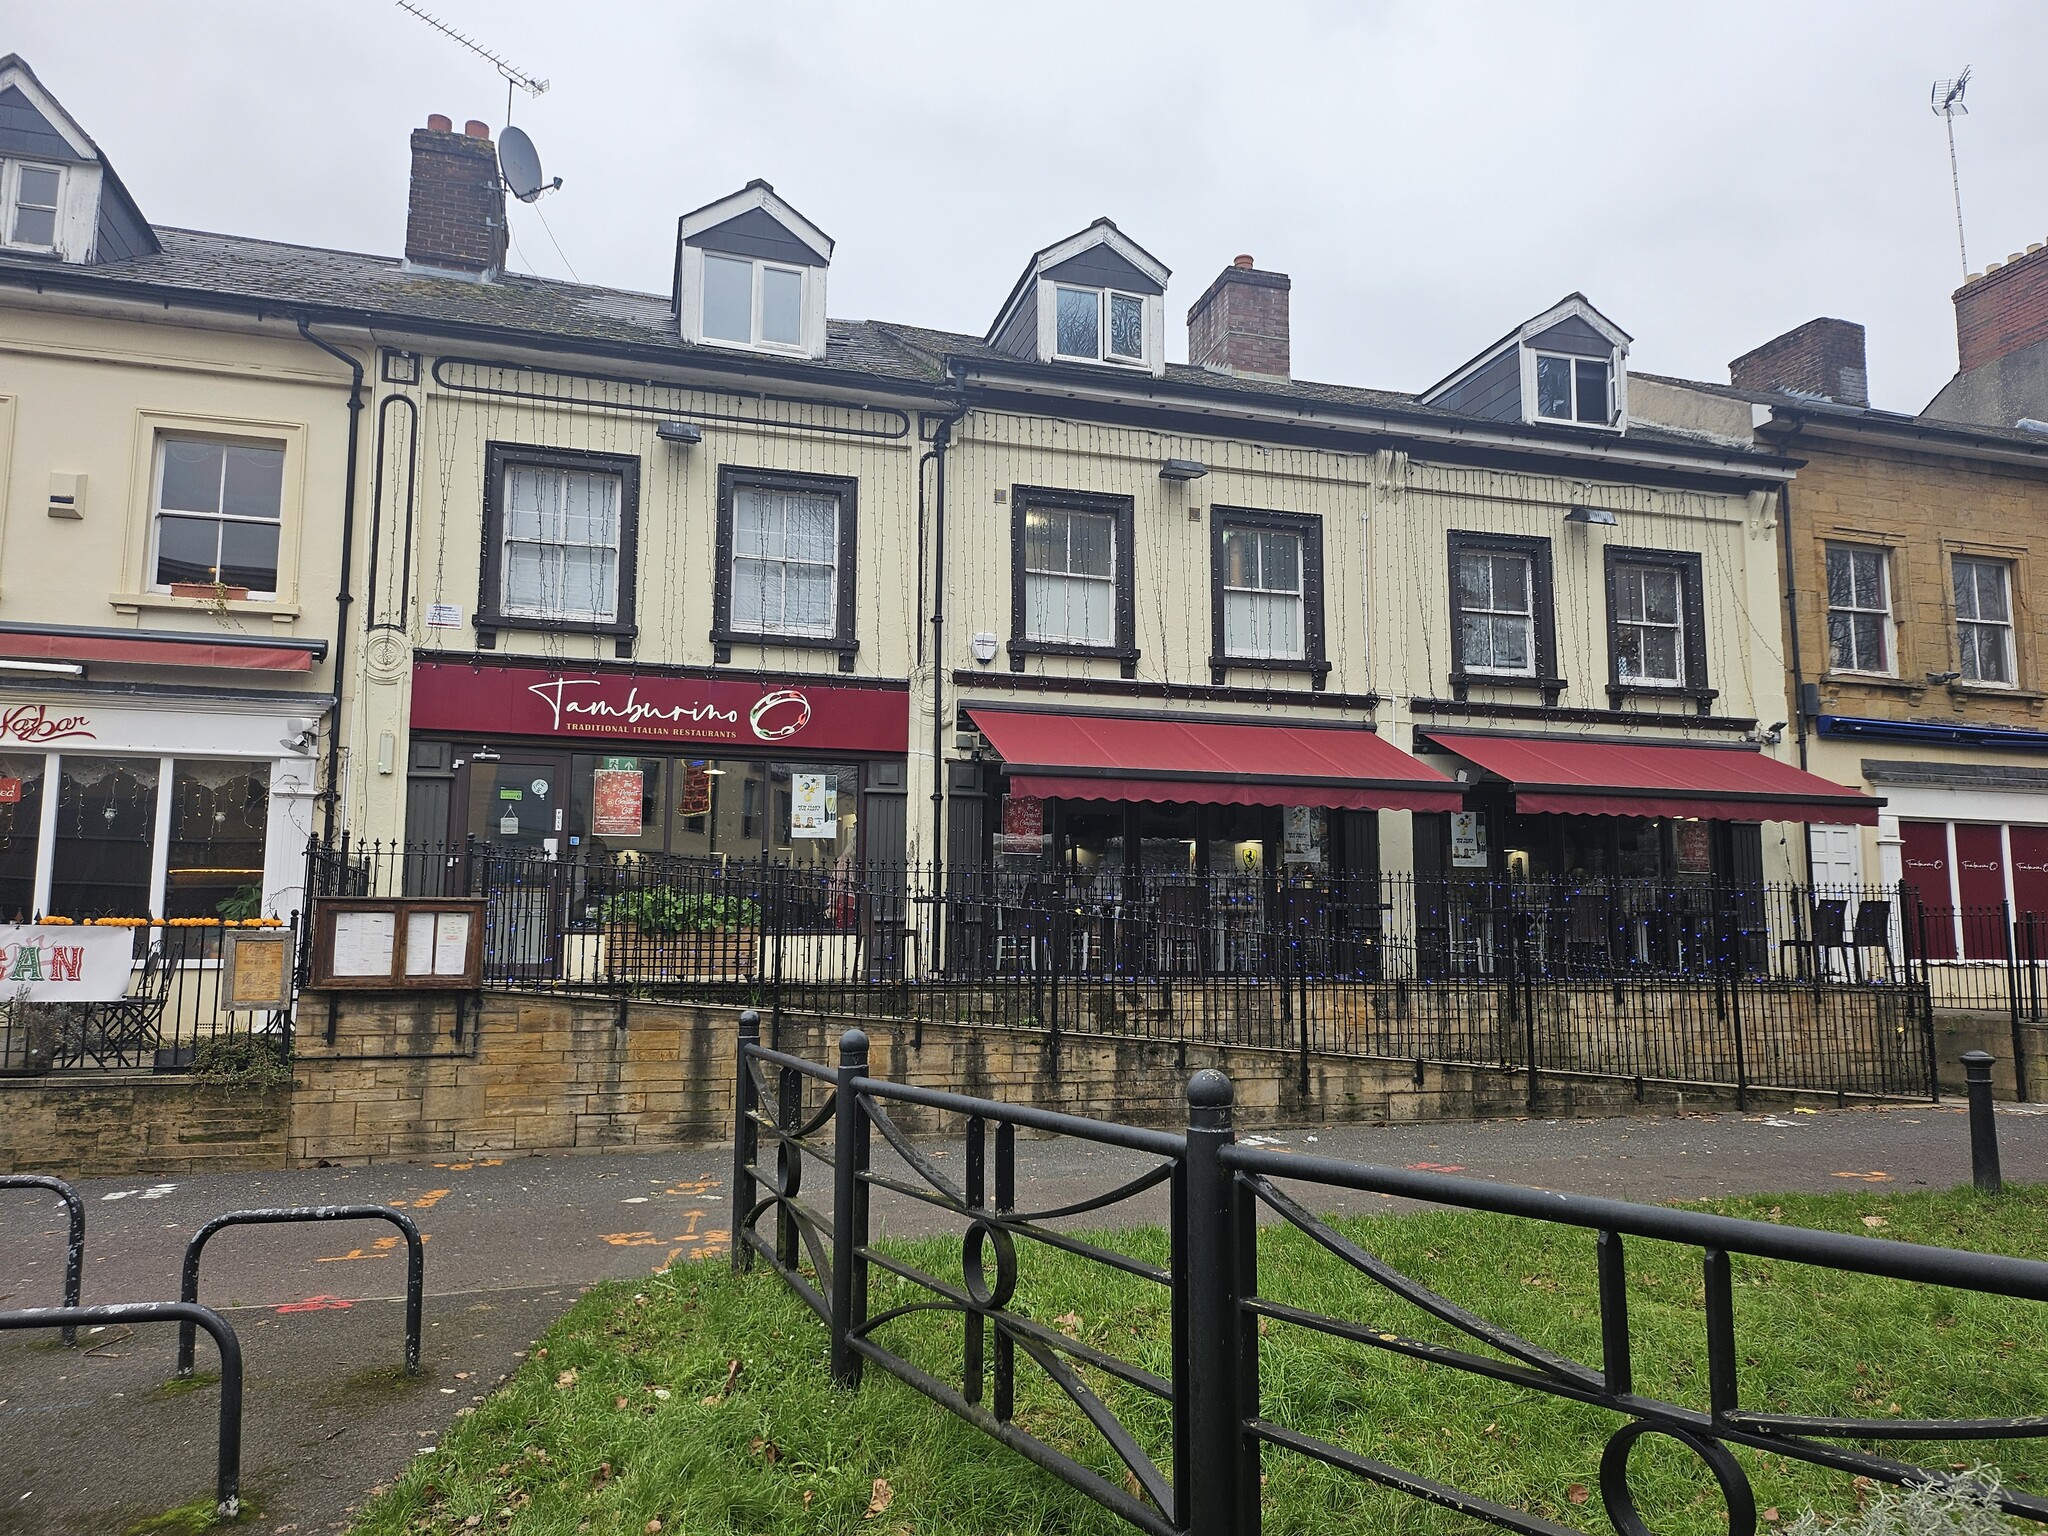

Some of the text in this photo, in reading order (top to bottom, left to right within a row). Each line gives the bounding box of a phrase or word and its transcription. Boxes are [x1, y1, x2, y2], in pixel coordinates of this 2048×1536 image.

[528, 677, 738, 731] Tamburino
[566, 723, 737, 739] TRADITIONAL ITALIAN RESTAURANTS
